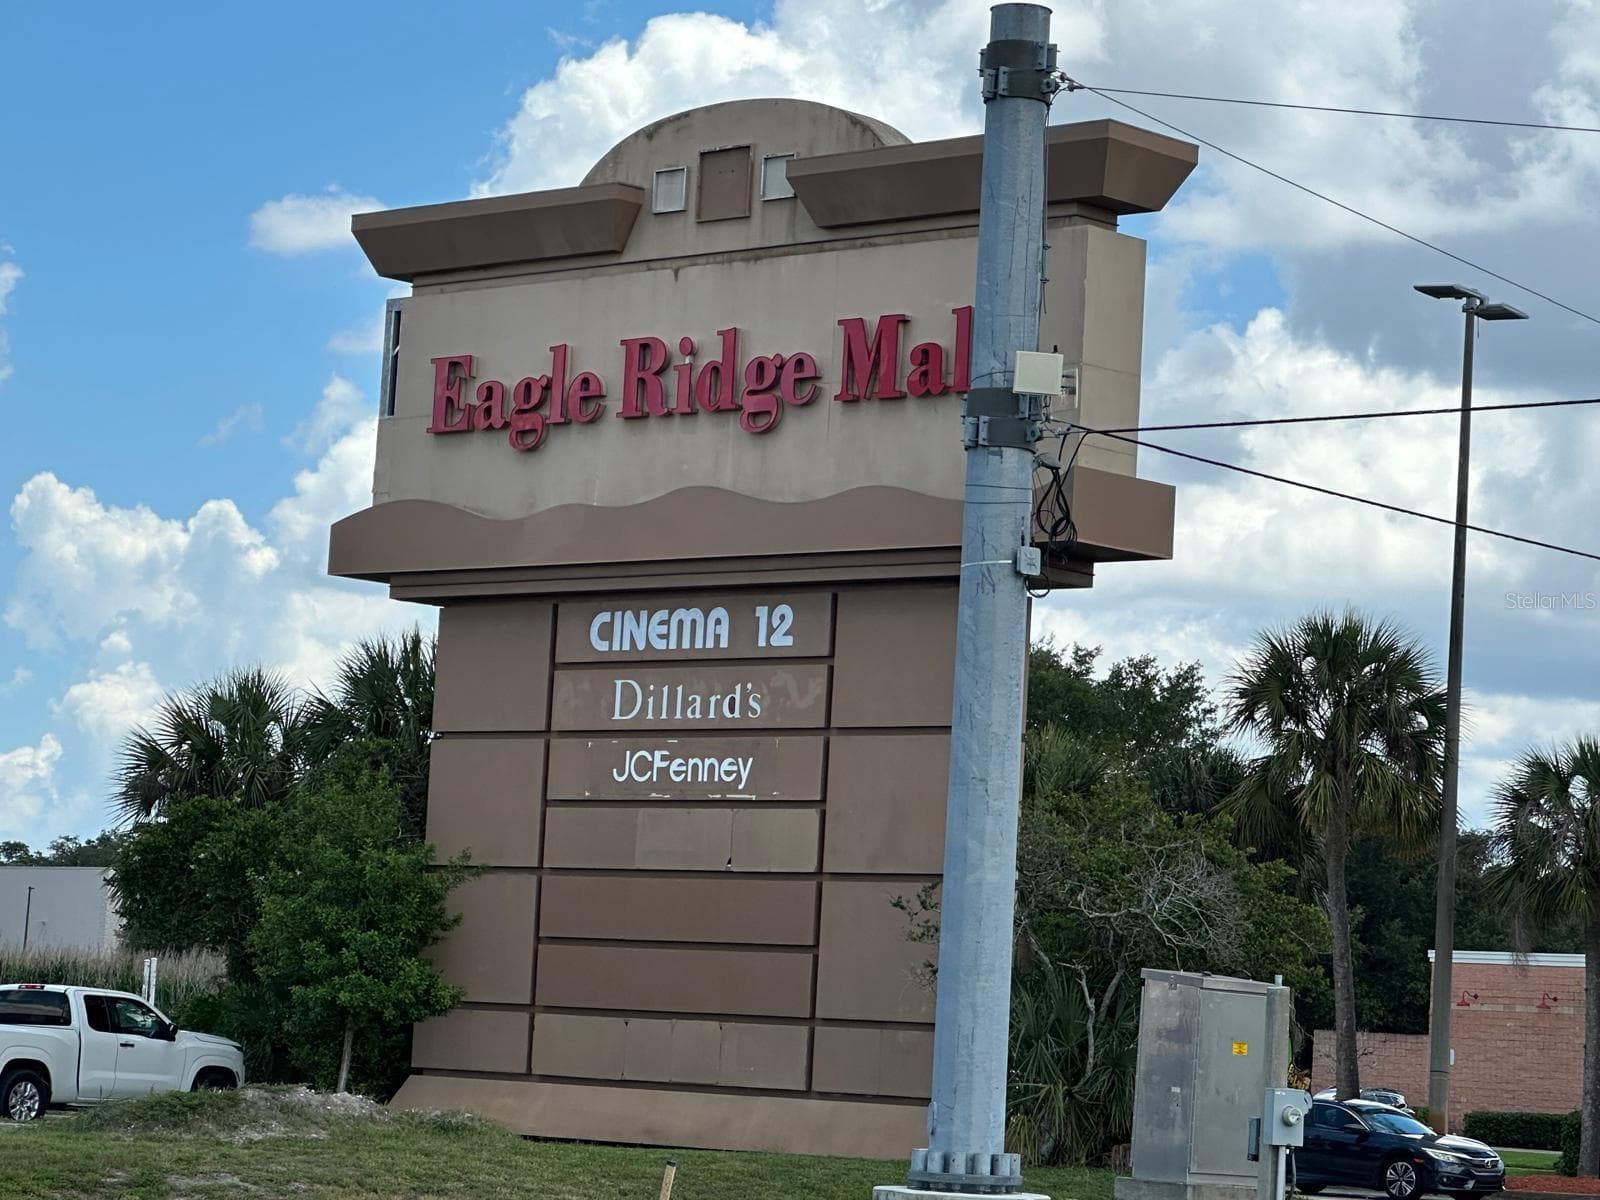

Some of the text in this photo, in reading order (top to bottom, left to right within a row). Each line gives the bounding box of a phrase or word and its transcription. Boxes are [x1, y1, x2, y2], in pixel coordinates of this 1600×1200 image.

[427, 305, 974, 452] Eagle Ridge Mal
[589, 604, 794, 651] CINEMA 12
[611, 679, 761, 720] Dillard's
